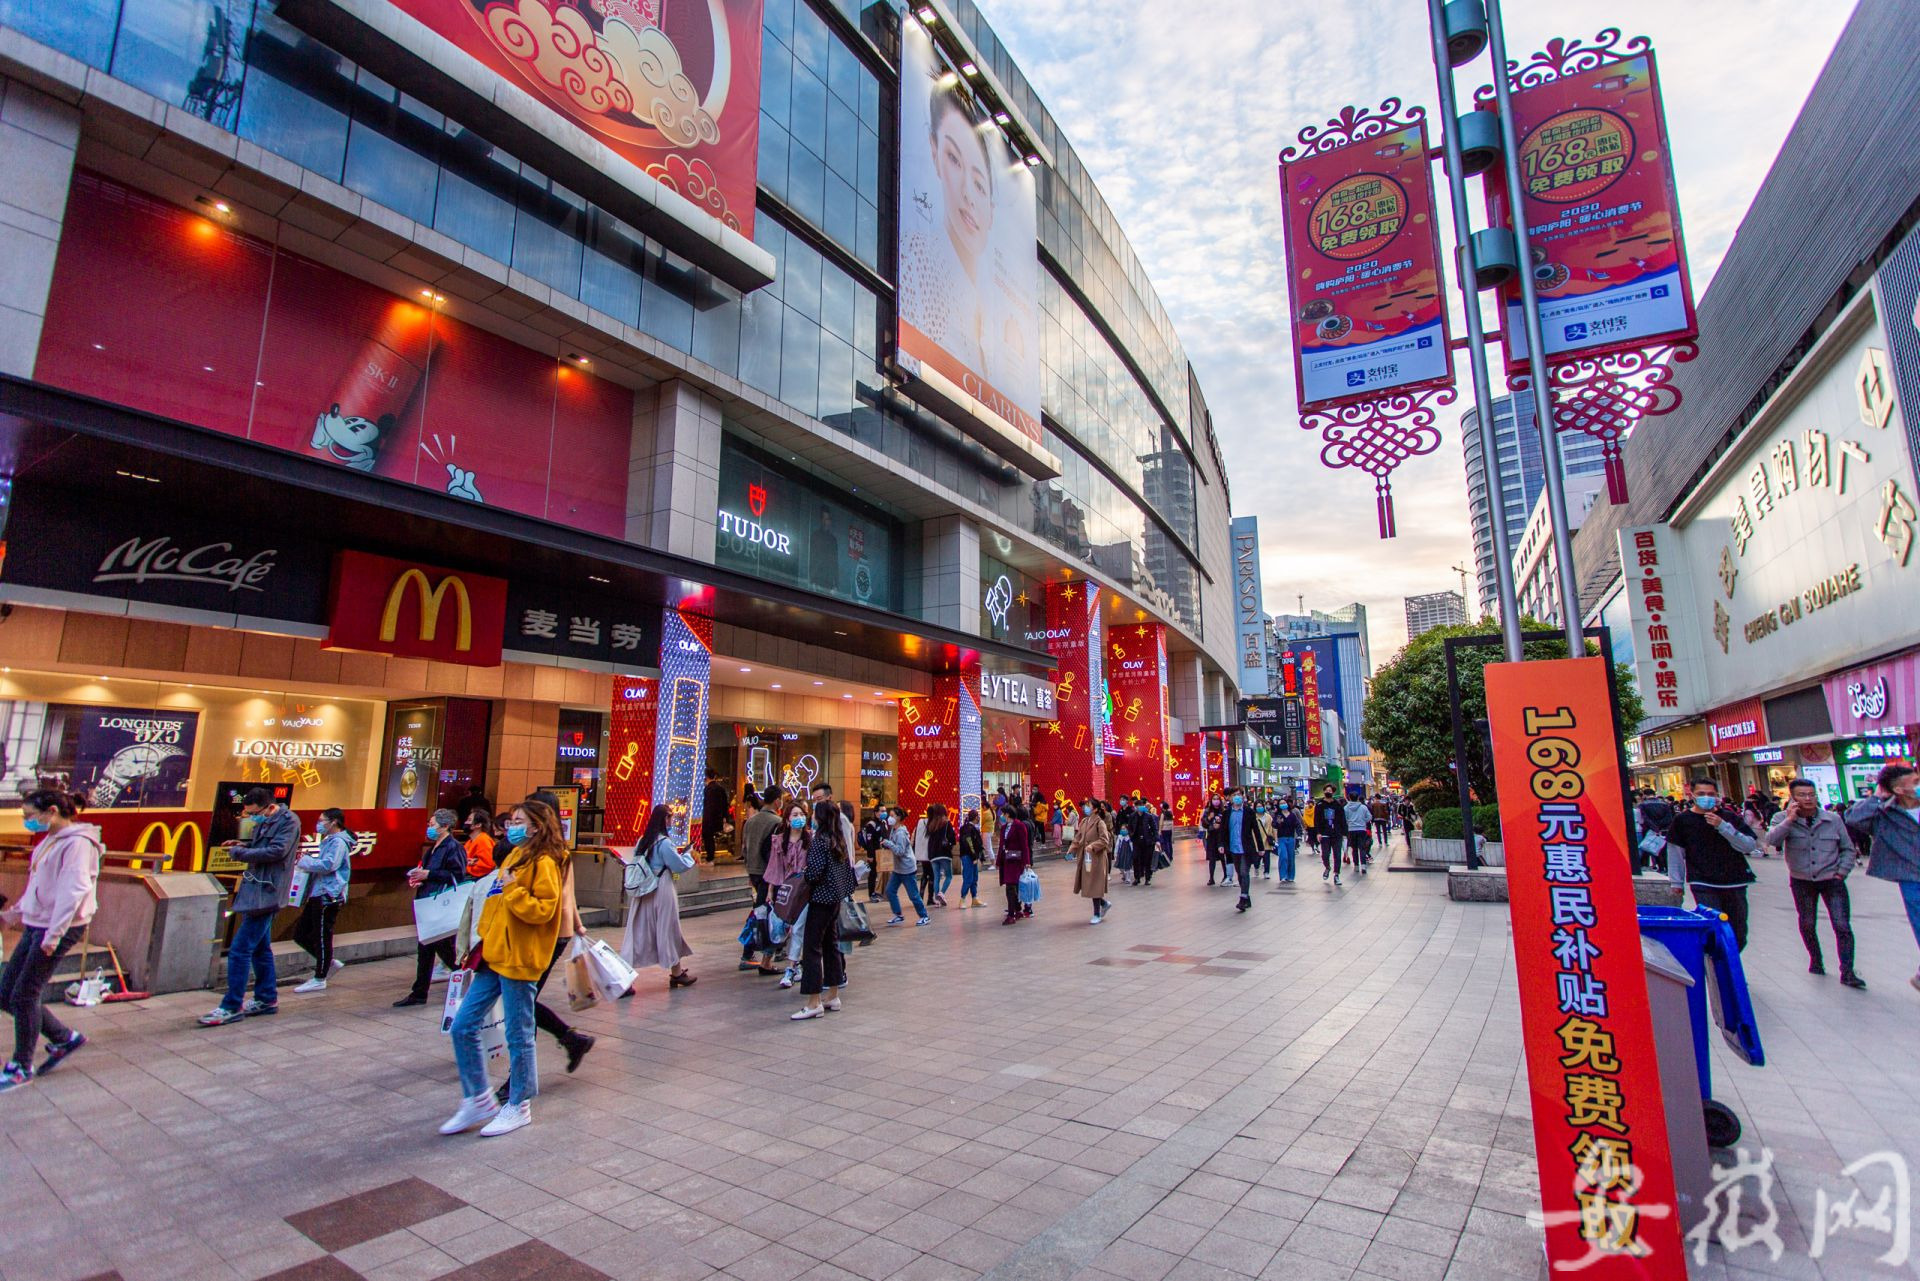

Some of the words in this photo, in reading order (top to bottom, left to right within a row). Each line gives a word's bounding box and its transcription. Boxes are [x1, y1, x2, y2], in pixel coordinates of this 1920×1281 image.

[1529, 155, 1625, 194] 免费领取
[1561, 202, 1600, 218] 2020
[1321, 218, 1400, 252] 免费领取
[1346, 260, 1378, 274] 2020
[1589, 315, 1628, 331] 支付宝
[1591, 325, 1628, 337] ALIPAY
[1368, 363, 1399, 378] 支付宝
[1369, 372, 1399, 383] ALIPAY
[961, 371, 1042, 445] CLARINS
[718, 509, 791, 555] TUDOR
[93, 536, 277, 592] McCafé
[1236, 532, 1258, 626] PARKSON
[1802, 563, 1863, 614] SQUARE
[521, 609, 642, 650] 麦当劳
[1046, 628, 1071, 639] OLAY
[1242, 632, 1263, 669] 百盛
[1122, 661, 1144, 669] OLAY
[624, 688, 648, 699] OLAY
[99, 717, 184, 731] LONGINES
[914, 725, 941, 737] OLAY
[1718, 722, 1743, 740] YEARCON
[234, 739, 345, 759] LONGINES
[559, 746, 595, 757] TUDOR
